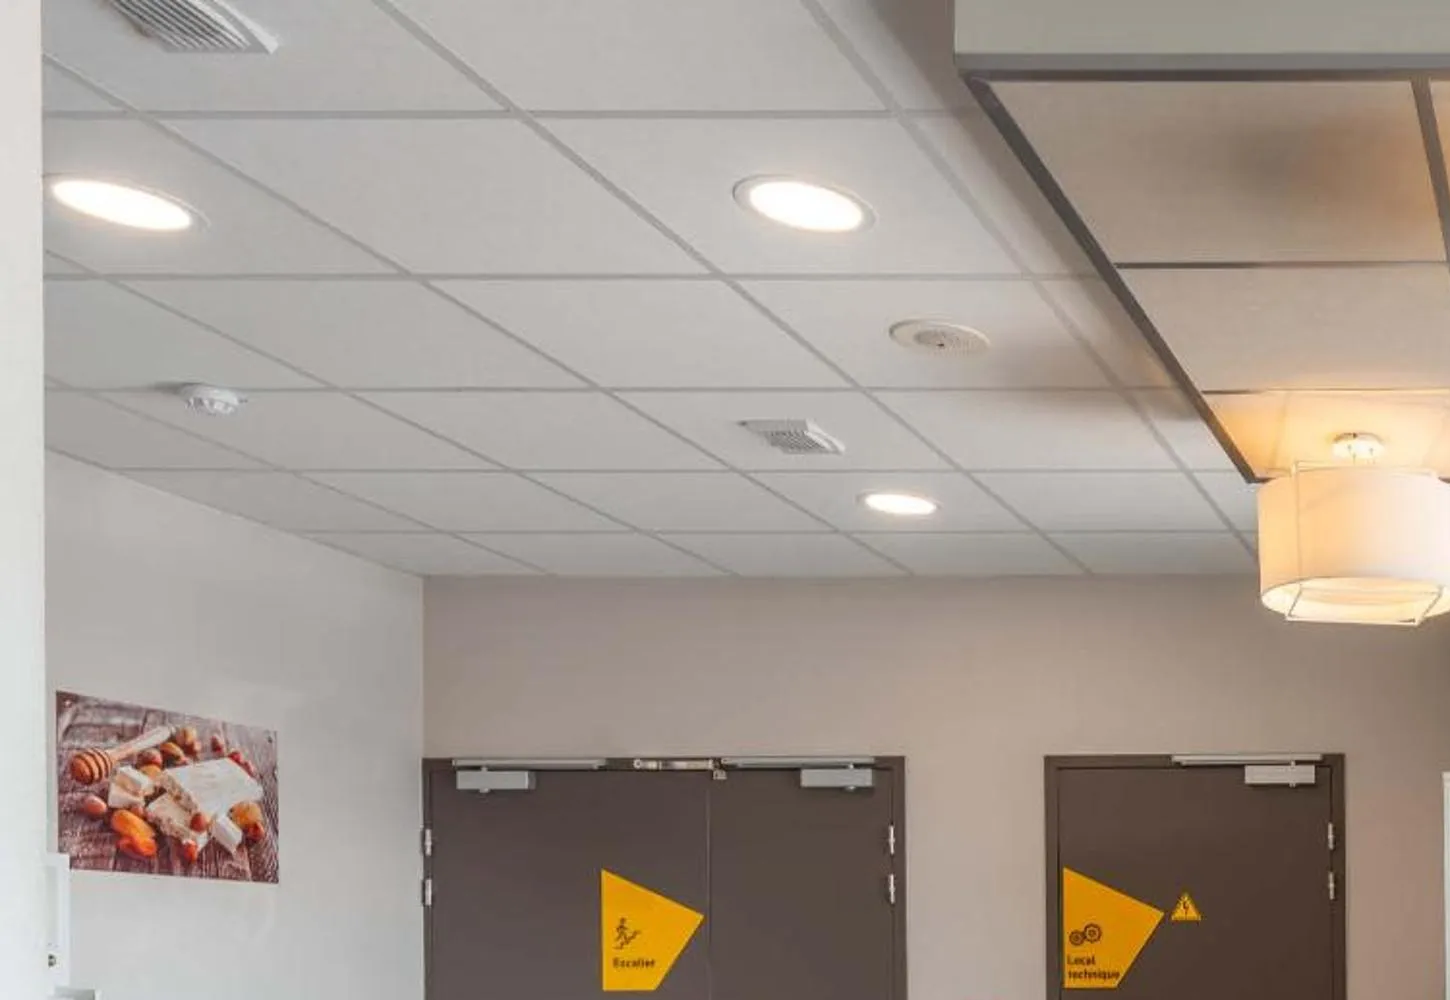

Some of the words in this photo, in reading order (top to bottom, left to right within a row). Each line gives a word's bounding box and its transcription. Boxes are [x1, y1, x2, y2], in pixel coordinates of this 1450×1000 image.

[612, 957, 656, 969] Escalier
[1066, 954, 1096, 965] Local
[1067, 970, 1120, 981] technique
